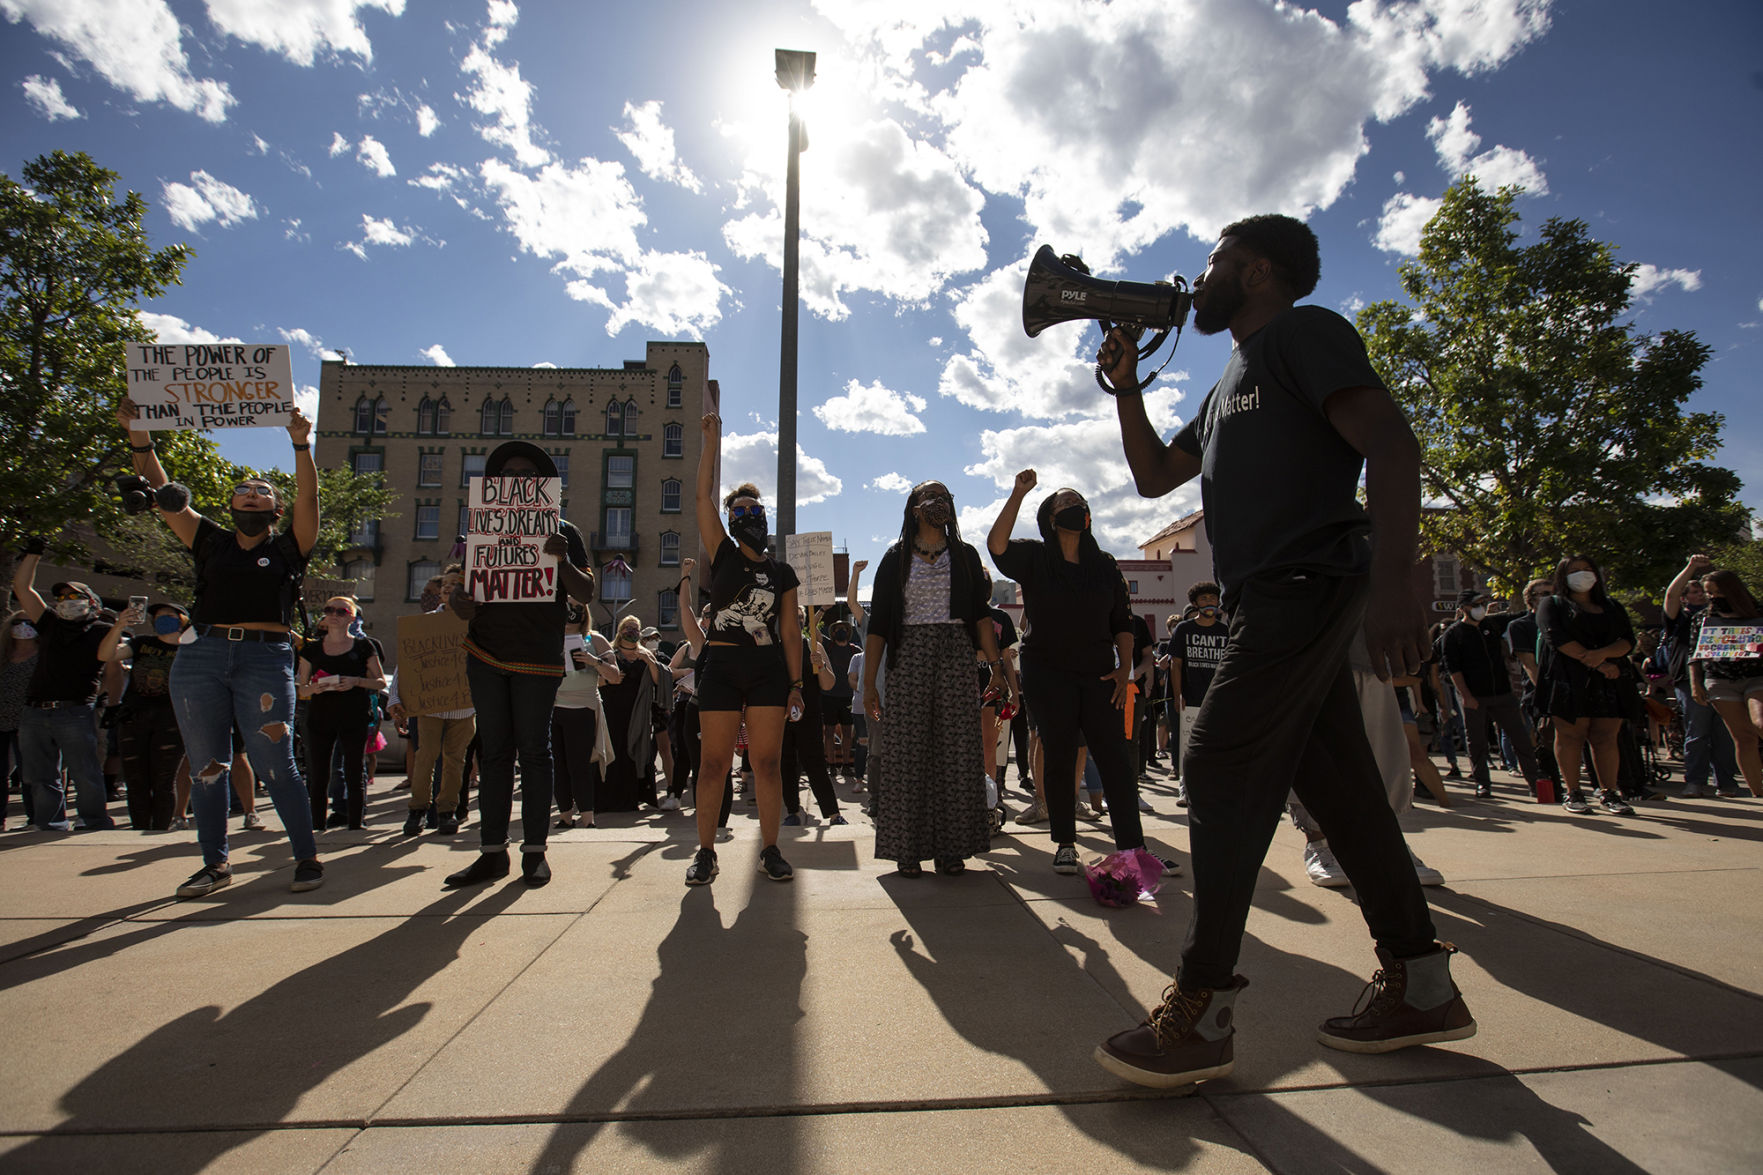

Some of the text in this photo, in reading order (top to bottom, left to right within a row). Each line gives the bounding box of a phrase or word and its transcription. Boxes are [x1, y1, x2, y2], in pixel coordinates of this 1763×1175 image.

[1061, 290, 1087, 301] PYLE
[137, 345, 276, 366] THE POWER OF
[130, 367, 266, 382] THE PEOPLE IS
[164, 381, 282, 404] STRONGER
[136, 401, 292, 420] THAN THE PEOPLE
[175, 416, 256, 427] IN POWER
[482, 477, 553, 506] BLACK
[499, 537, 520, 546] AND
[474, 545, 540, 567] FUTURES
[469, 567, 554, 601] MATTER!
[1186, 634, 1227, 647] I CAN'T
